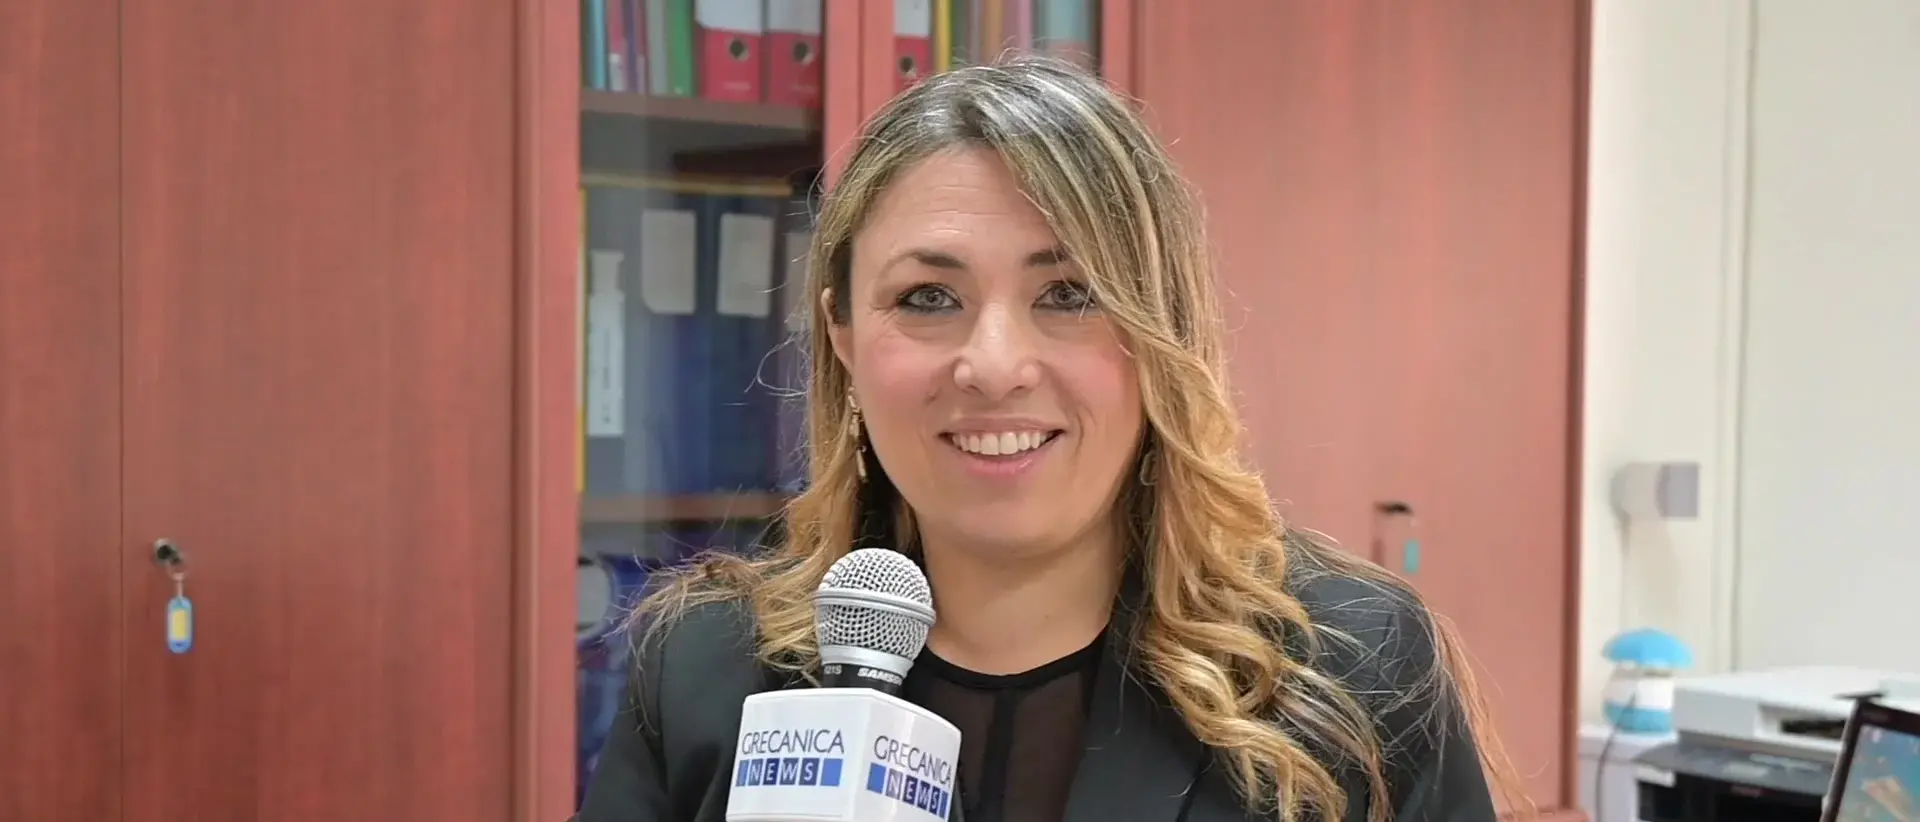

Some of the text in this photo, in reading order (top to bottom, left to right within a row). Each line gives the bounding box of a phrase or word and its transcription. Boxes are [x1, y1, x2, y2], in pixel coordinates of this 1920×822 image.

[742, 729, 845, 755] GRECANICA
[749, 762, 814, 782] NEWS
[887, 771, 938, 811] NEWS
